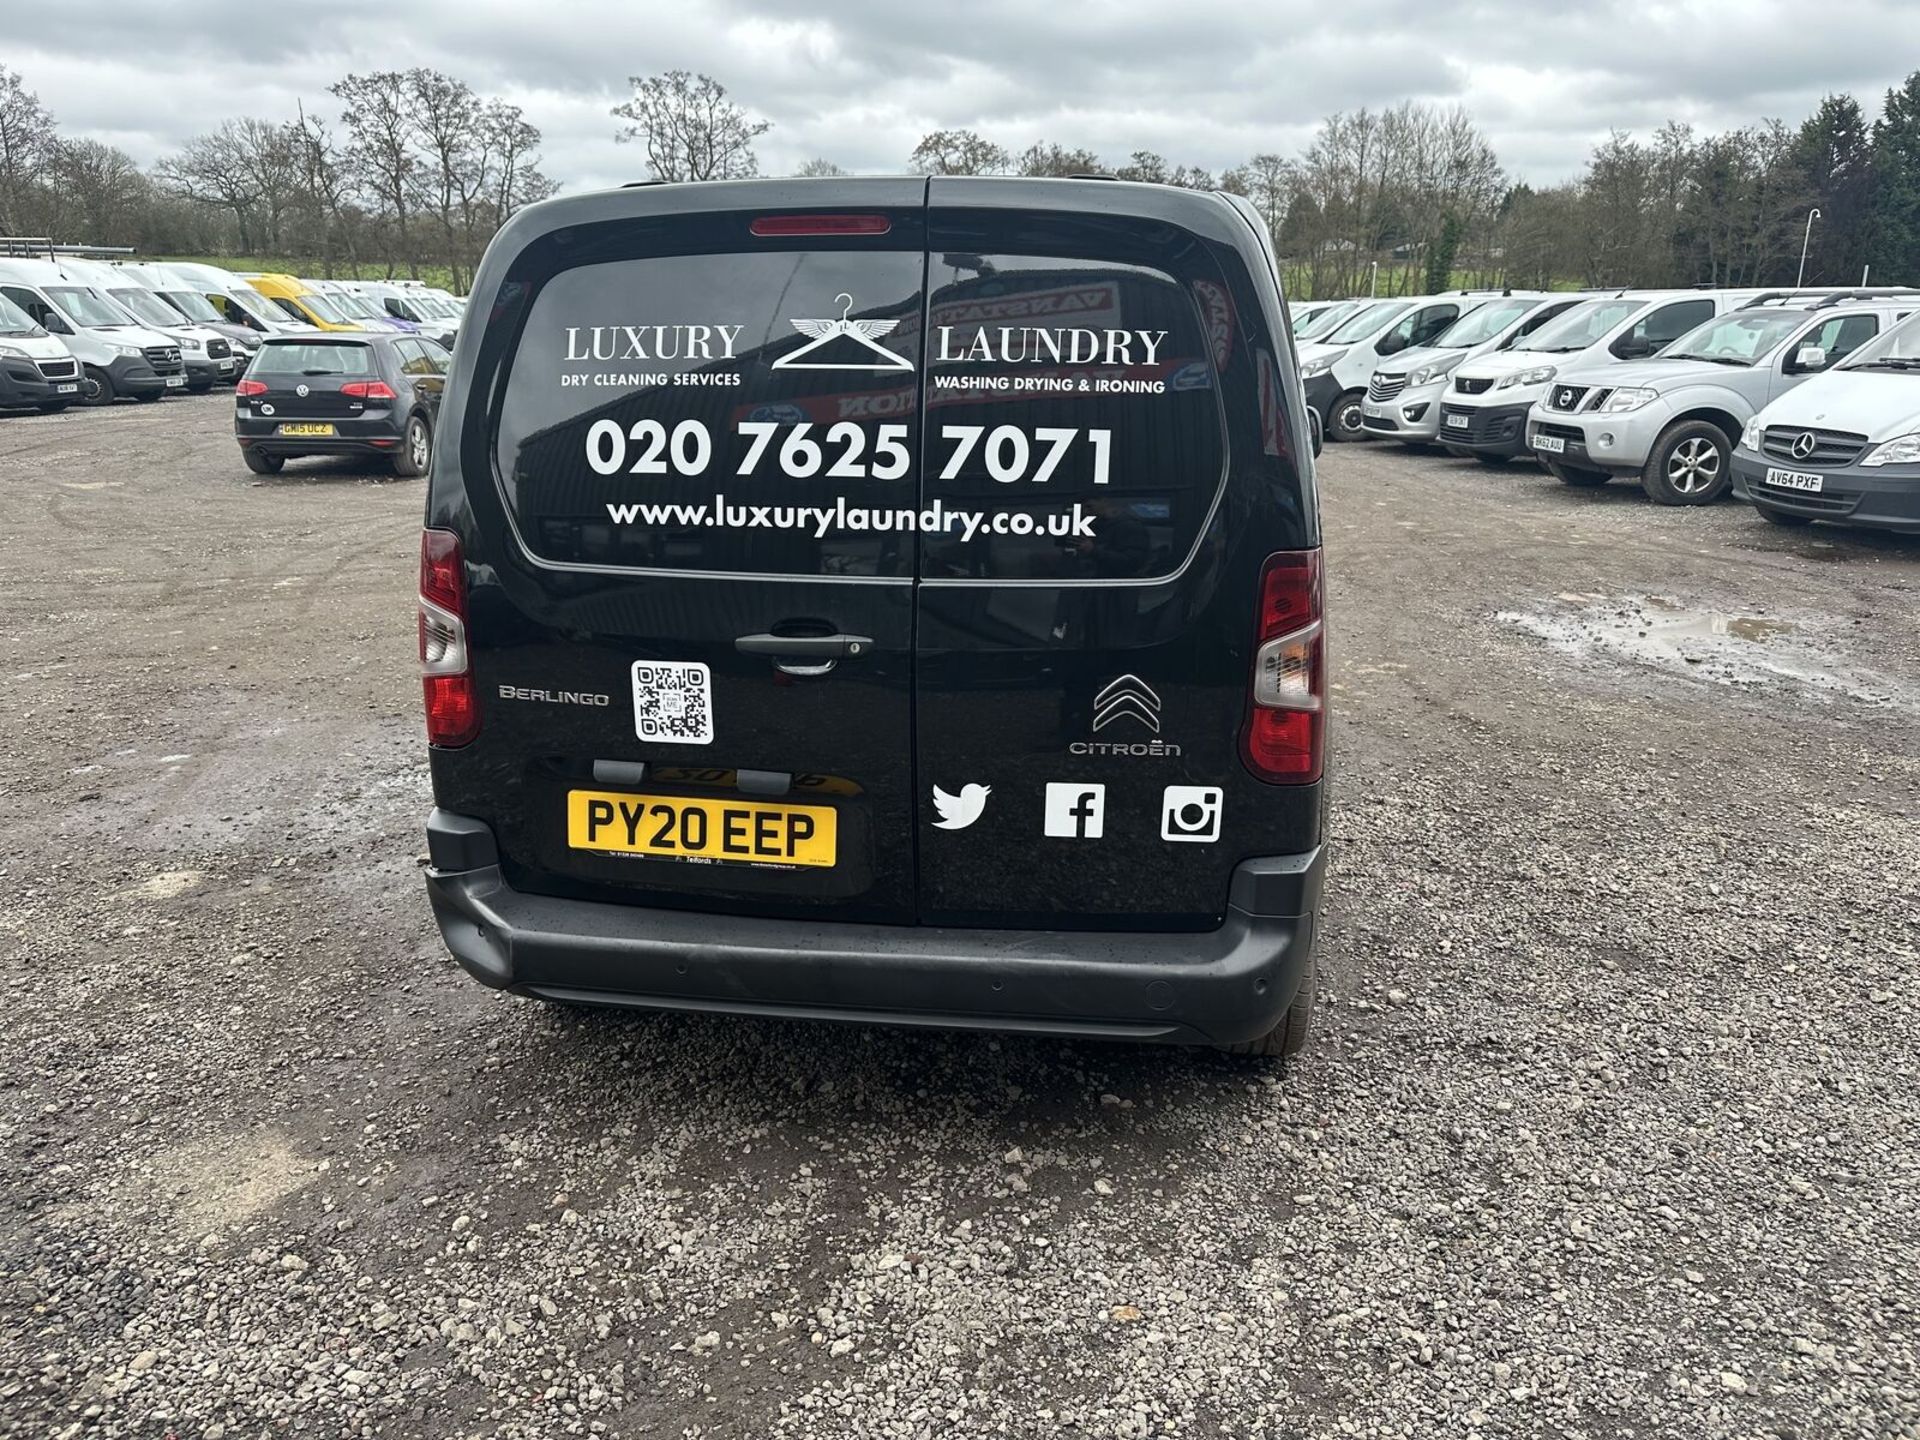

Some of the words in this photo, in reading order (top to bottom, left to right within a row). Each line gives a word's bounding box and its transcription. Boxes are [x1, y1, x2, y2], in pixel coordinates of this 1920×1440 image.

[563, 324, 744, 361] LUXURY
[935, 325, 1169, 366] LAUNDRY
[561, 374, 590, 387] DRY
[593, 373, 668, 387] CLEANING
[673, 372, 741, 386] SERVICES
[935, 375, 1009, 390] WASHING
[1014, 377, 1074, 392] DRYING
[1078, 379, 1091, 392] &
[1095, 380, 1166, 394] IRONING
[587, 419, 711, 476] 020
[736, 421, 910, 480] 7625
[940, 425, 1112, 484] 7071
[1770, 470, 1794, 486] AV64
[1796, 474, 1819, 489] PXF
[607, 495, 1097, 542] www.luxurylaundry.co.uk
[588, 799, 708, 851] PY20
[722, 808, 815, 858] EEP
